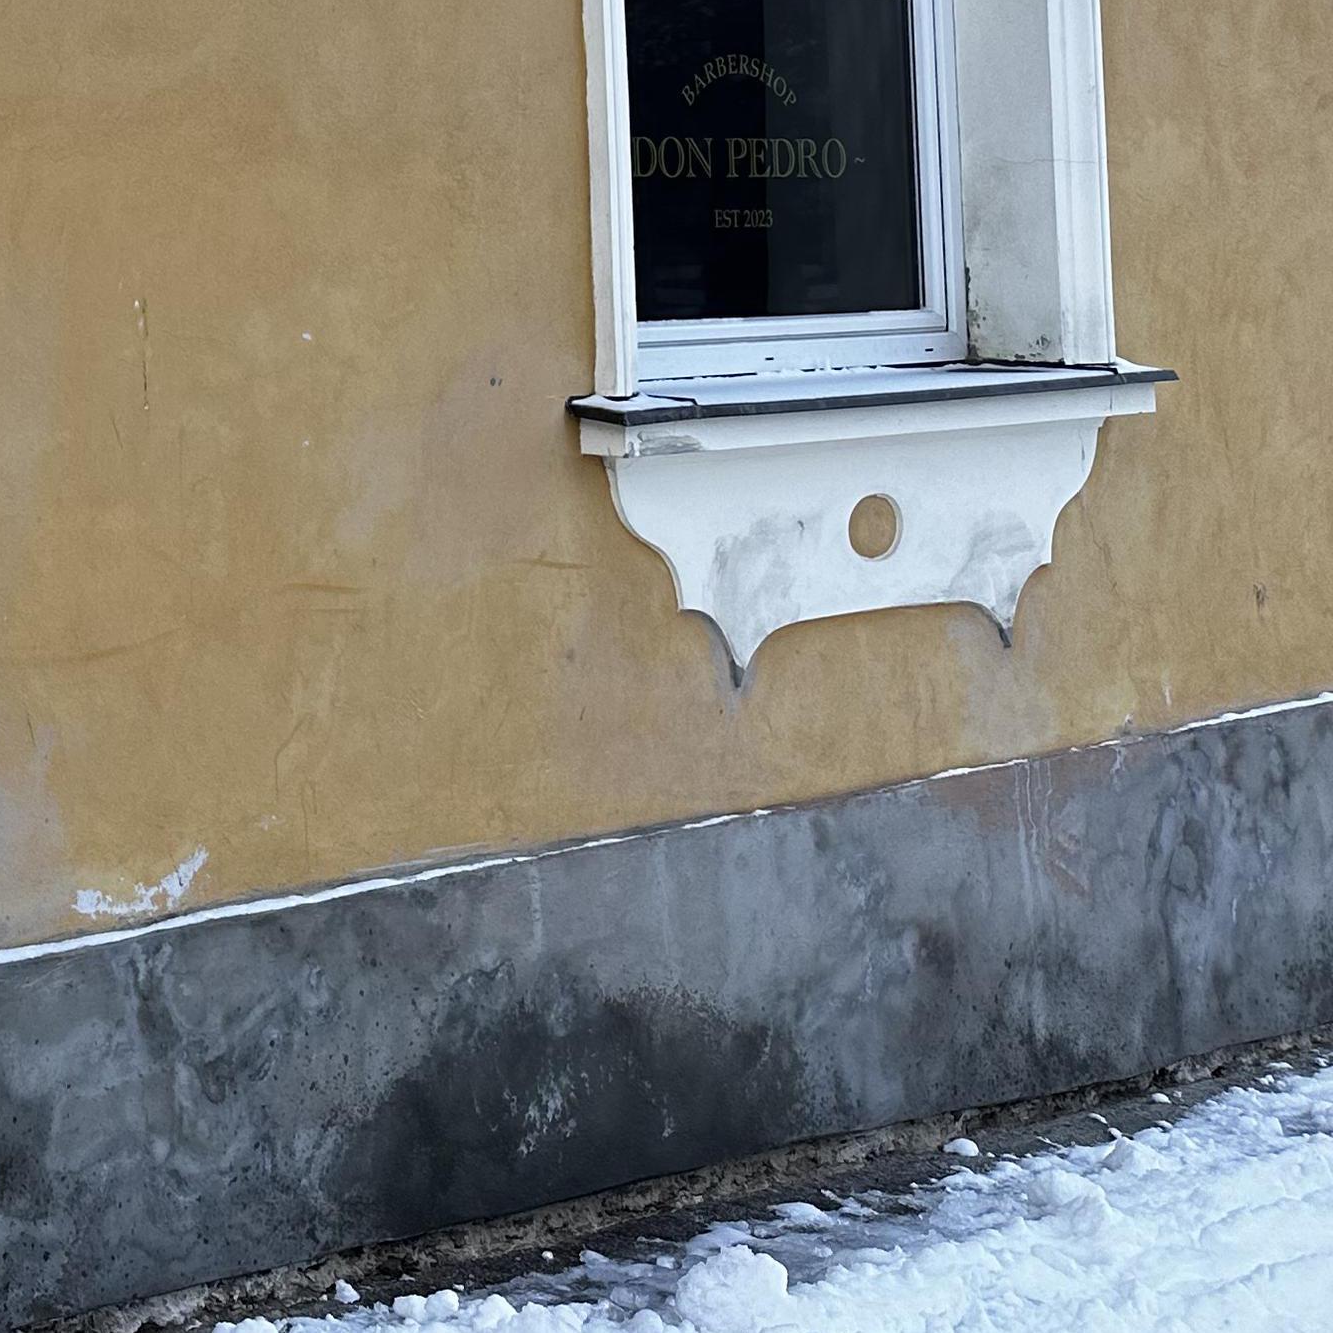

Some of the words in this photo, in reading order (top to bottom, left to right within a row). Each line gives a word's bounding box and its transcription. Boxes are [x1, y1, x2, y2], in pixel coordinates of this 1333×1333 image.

[681, 53, 797, 107] BARBERSHOP
[633, 135, 712, 179] DON
[725, 137, 847, 179] PEDRO
[714, 208, 741, 229] EST
[743, 208, 774, 229] 2023
